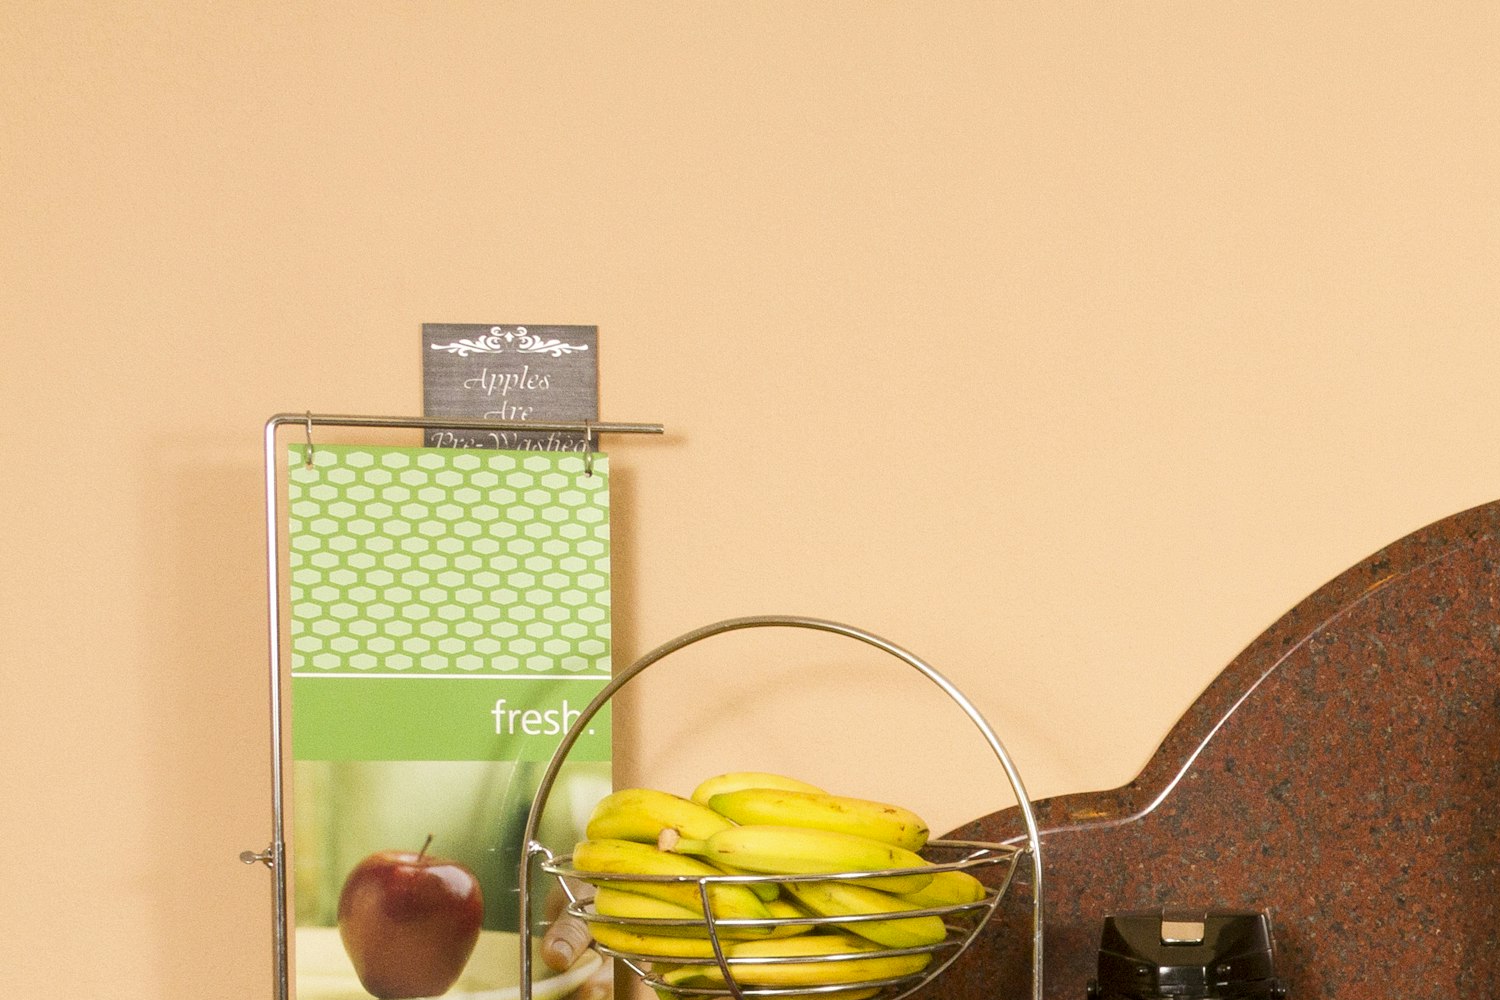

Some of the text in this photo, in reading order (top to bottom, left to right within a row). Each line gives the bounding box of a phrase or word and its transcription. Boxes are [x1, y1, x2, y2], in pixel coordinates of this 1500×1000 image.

[463, 365, 551, 396] Apples
[484, 401, 534, 420] Are
[491, 699, 595, 735] fresh.
